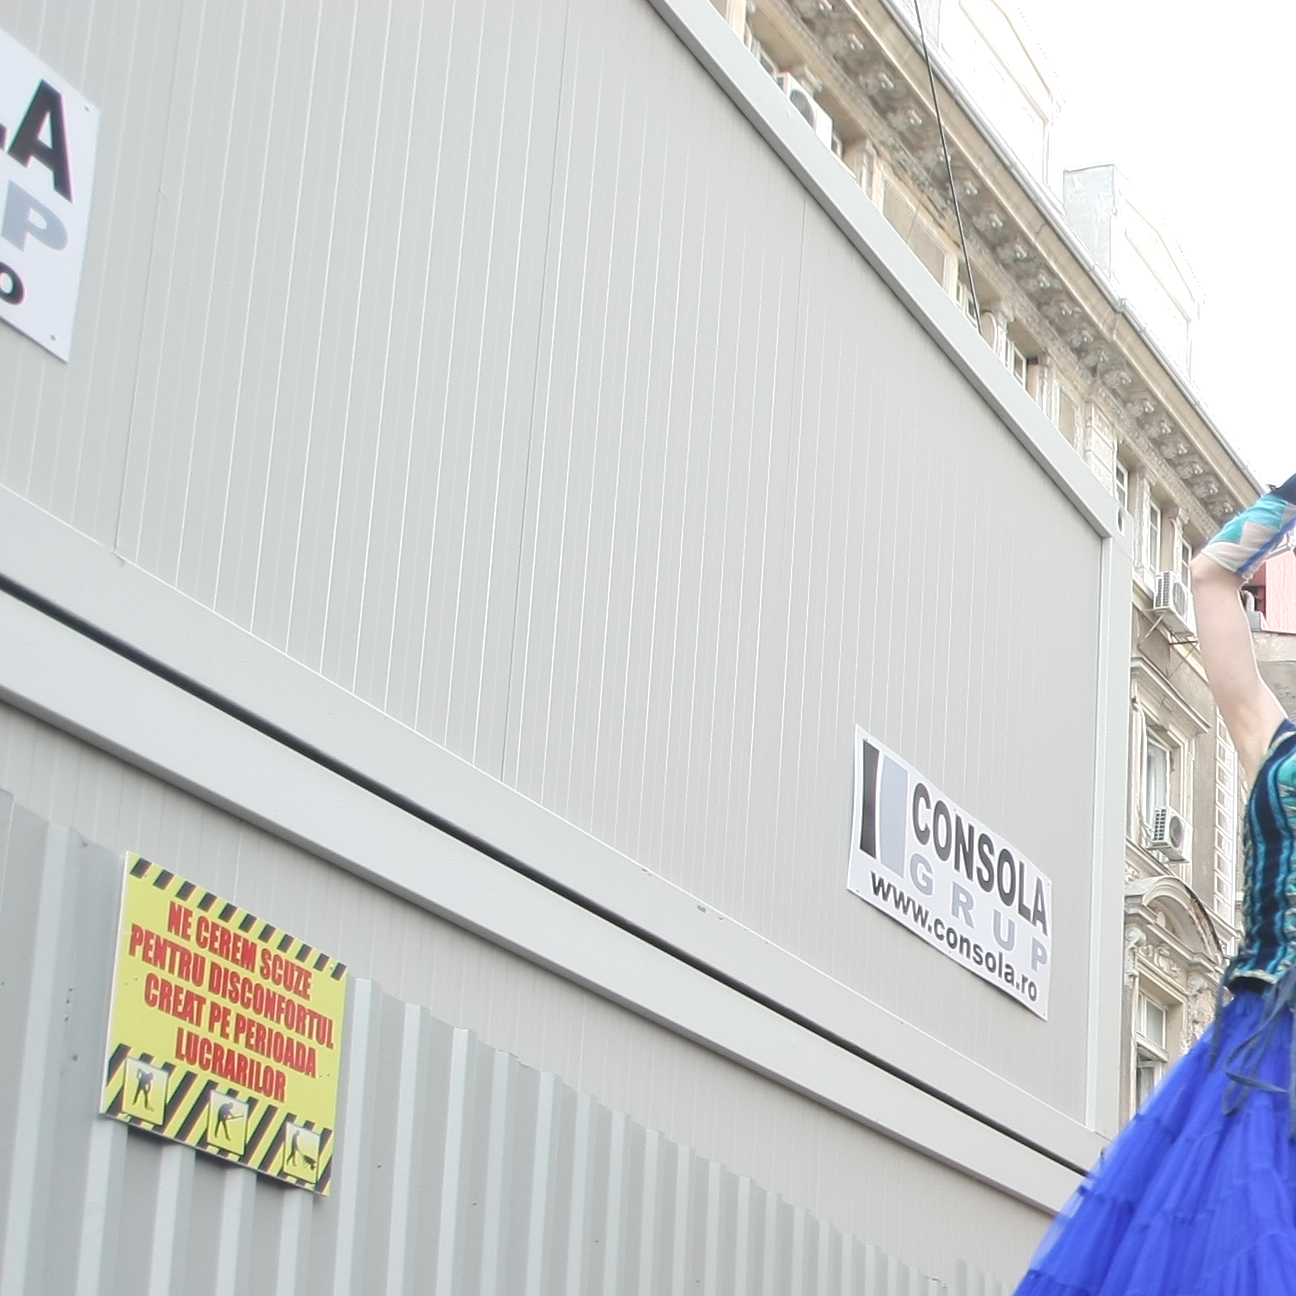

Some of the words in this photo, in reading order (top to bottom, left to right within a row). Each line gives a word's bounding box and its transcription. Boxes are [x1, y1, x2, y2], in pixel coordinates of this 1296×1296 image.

[910, 853, 1048, 971] GRUP
[912, 782, 1049, 937] CONSOLA
[129, 923, 205, 987] PENTRU
[208, 961, 335, 1049] DISCONFORTUL
[168, 901, 193, 941] NE
[196, 915, 257, 974] CEREM
[259, 948, 313, 1001] SCUZE
[870, 871, 1038, 1002] www.consola.ro
[144, 972, 207, 1028] CREAT
[208, 1000, 231, 1038] PE
[233, 1009, 317, 1079] PERIOADA
[175, 1027, 287, 1103] LUCRARILOR
